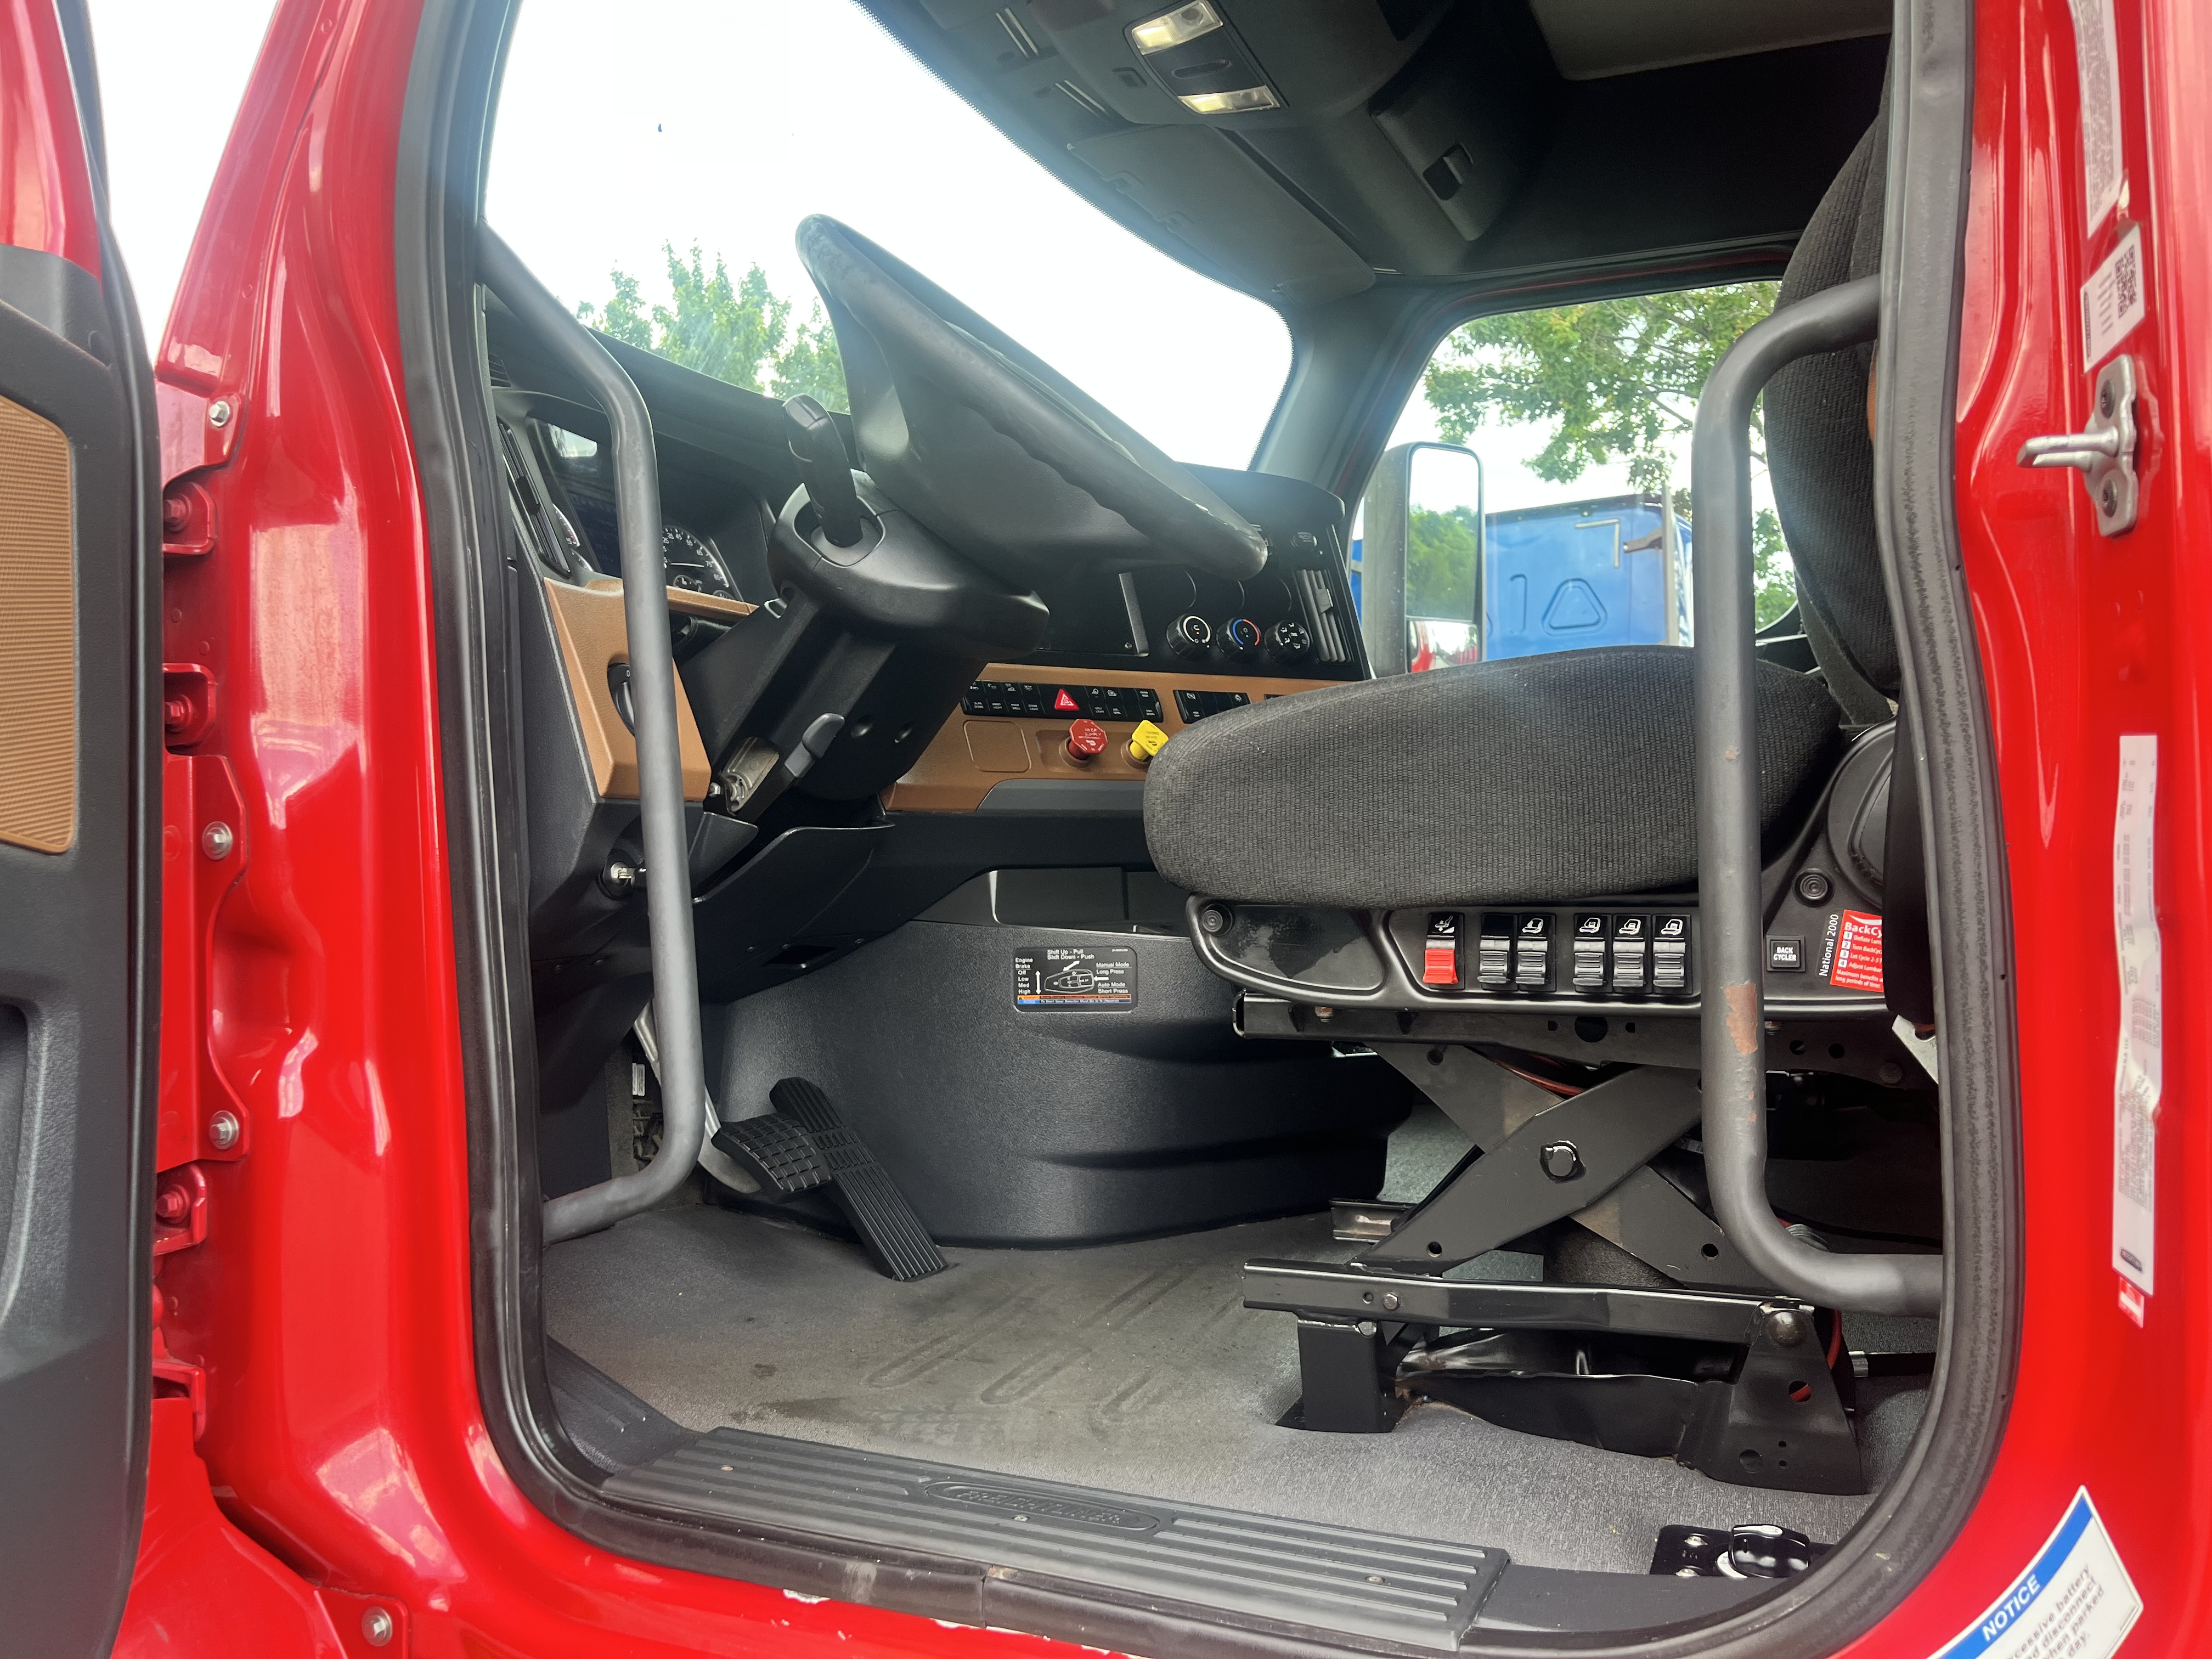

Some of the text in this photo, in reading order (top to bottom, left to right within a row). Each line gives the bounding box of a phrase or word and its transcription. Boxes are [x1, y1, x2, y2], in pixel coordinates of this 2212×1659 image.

[1819, 914, 1839, 977] National 2000
[1981, 1573, 2041, 1643] NOTICE
[2042, 1575, 2096, 1648] disconnect
[2056, 1564, 2090, 1613] battery
[2072, 1584, 2104, 1635] parked
